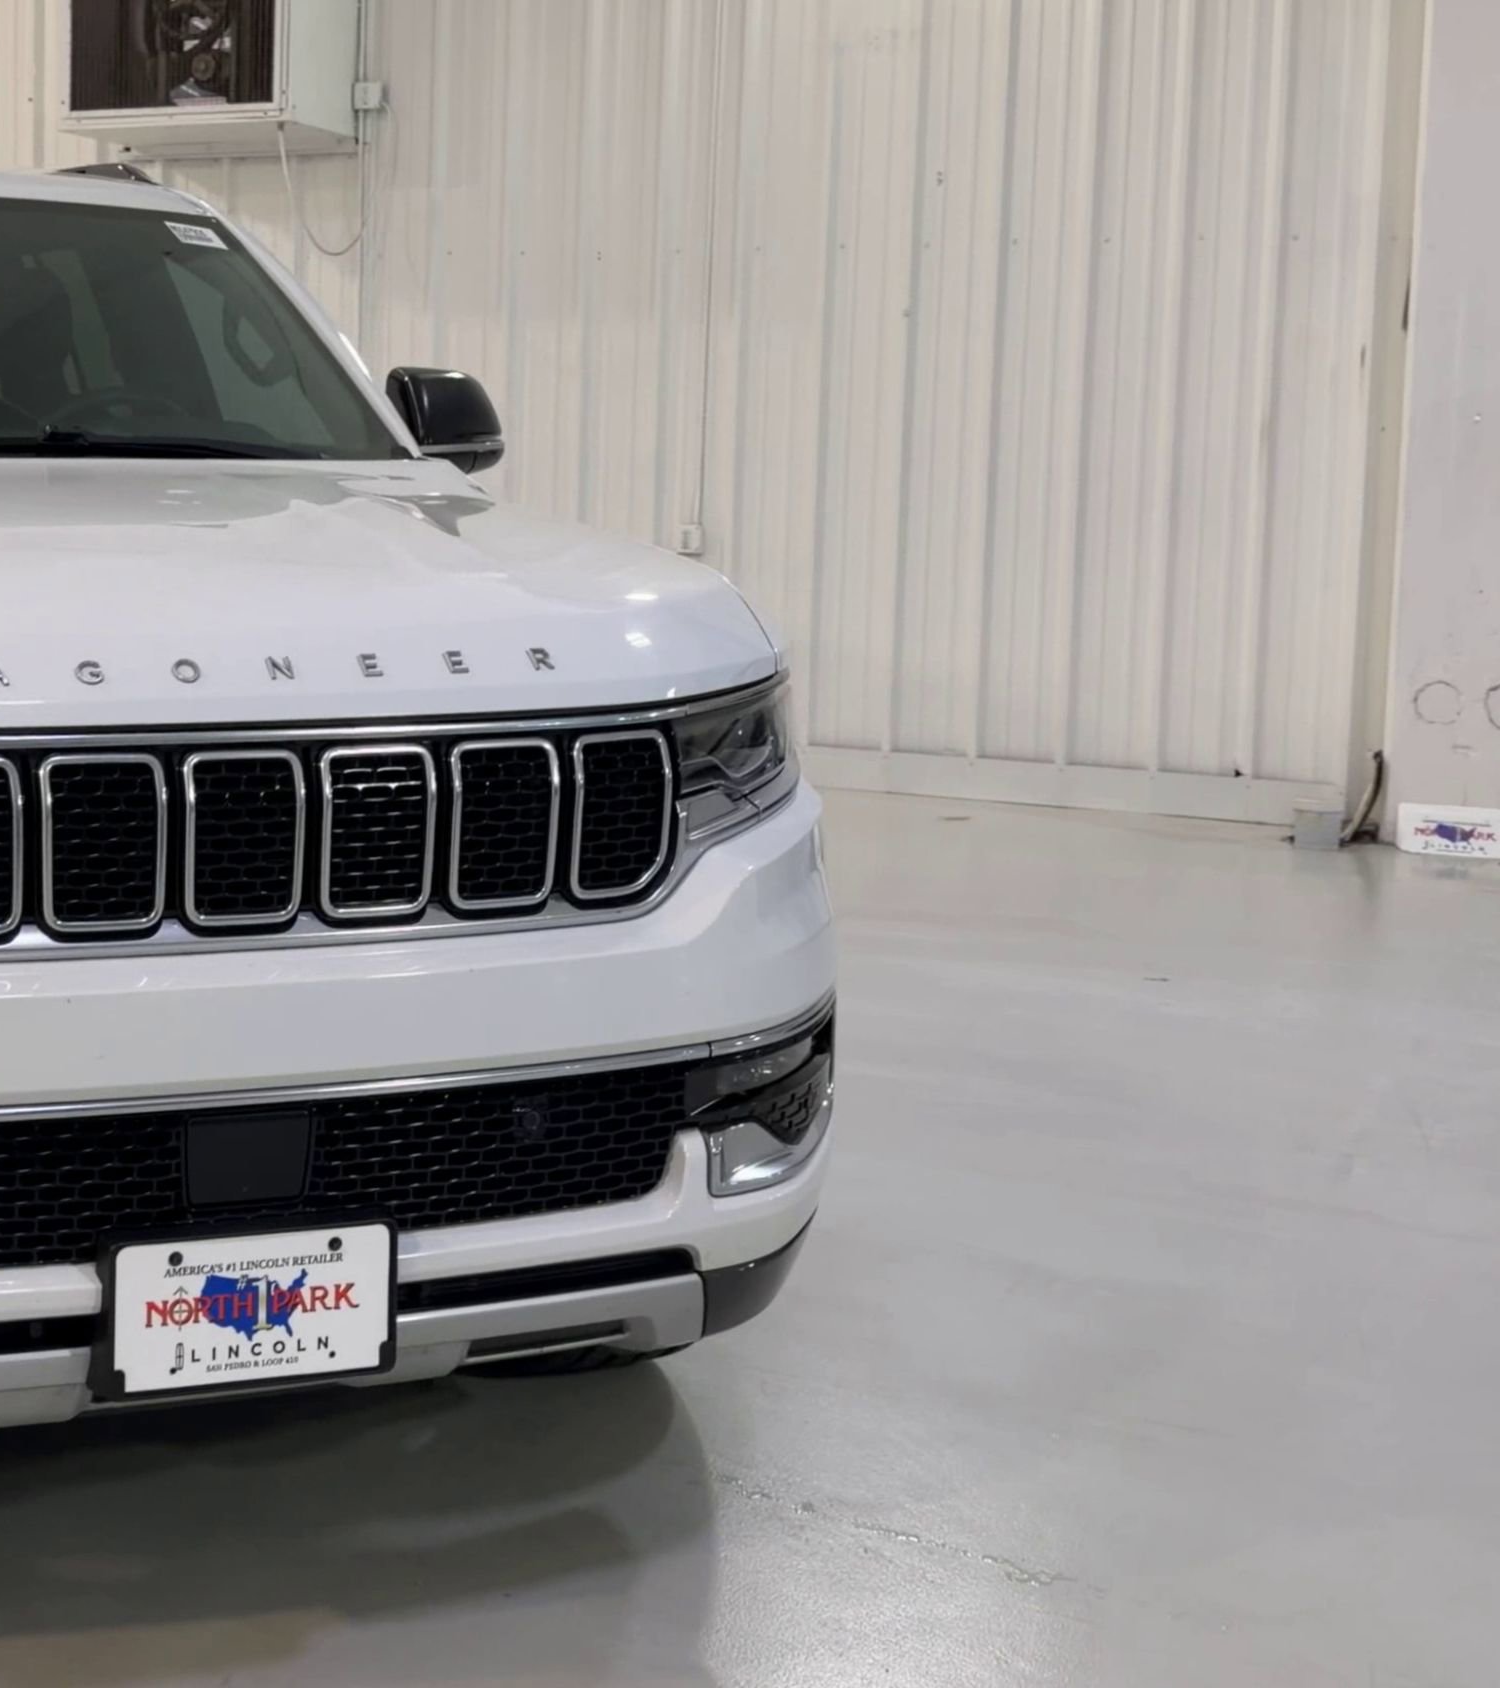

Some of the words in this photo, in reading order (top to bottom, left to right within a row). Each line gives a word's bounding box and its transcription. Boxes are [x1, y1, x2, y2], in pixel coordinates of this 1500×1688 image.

[164, 1263, 223, 1278] AMERICA'S
[226, 1262, 237, 1272] #1
[240, 1257, 290, 1271] LINCOLN
[292, 1252, 344, 1266] RETAILER
[145, 1291, 254, 1328] NORTH
[272, 1282, 360, 1314] PARK
[191, 1336, 329, 1363] LINCOLN
[223, 1360, 252, 1371] PEDRO
[261, 1357, 284, 1368] LOOP
